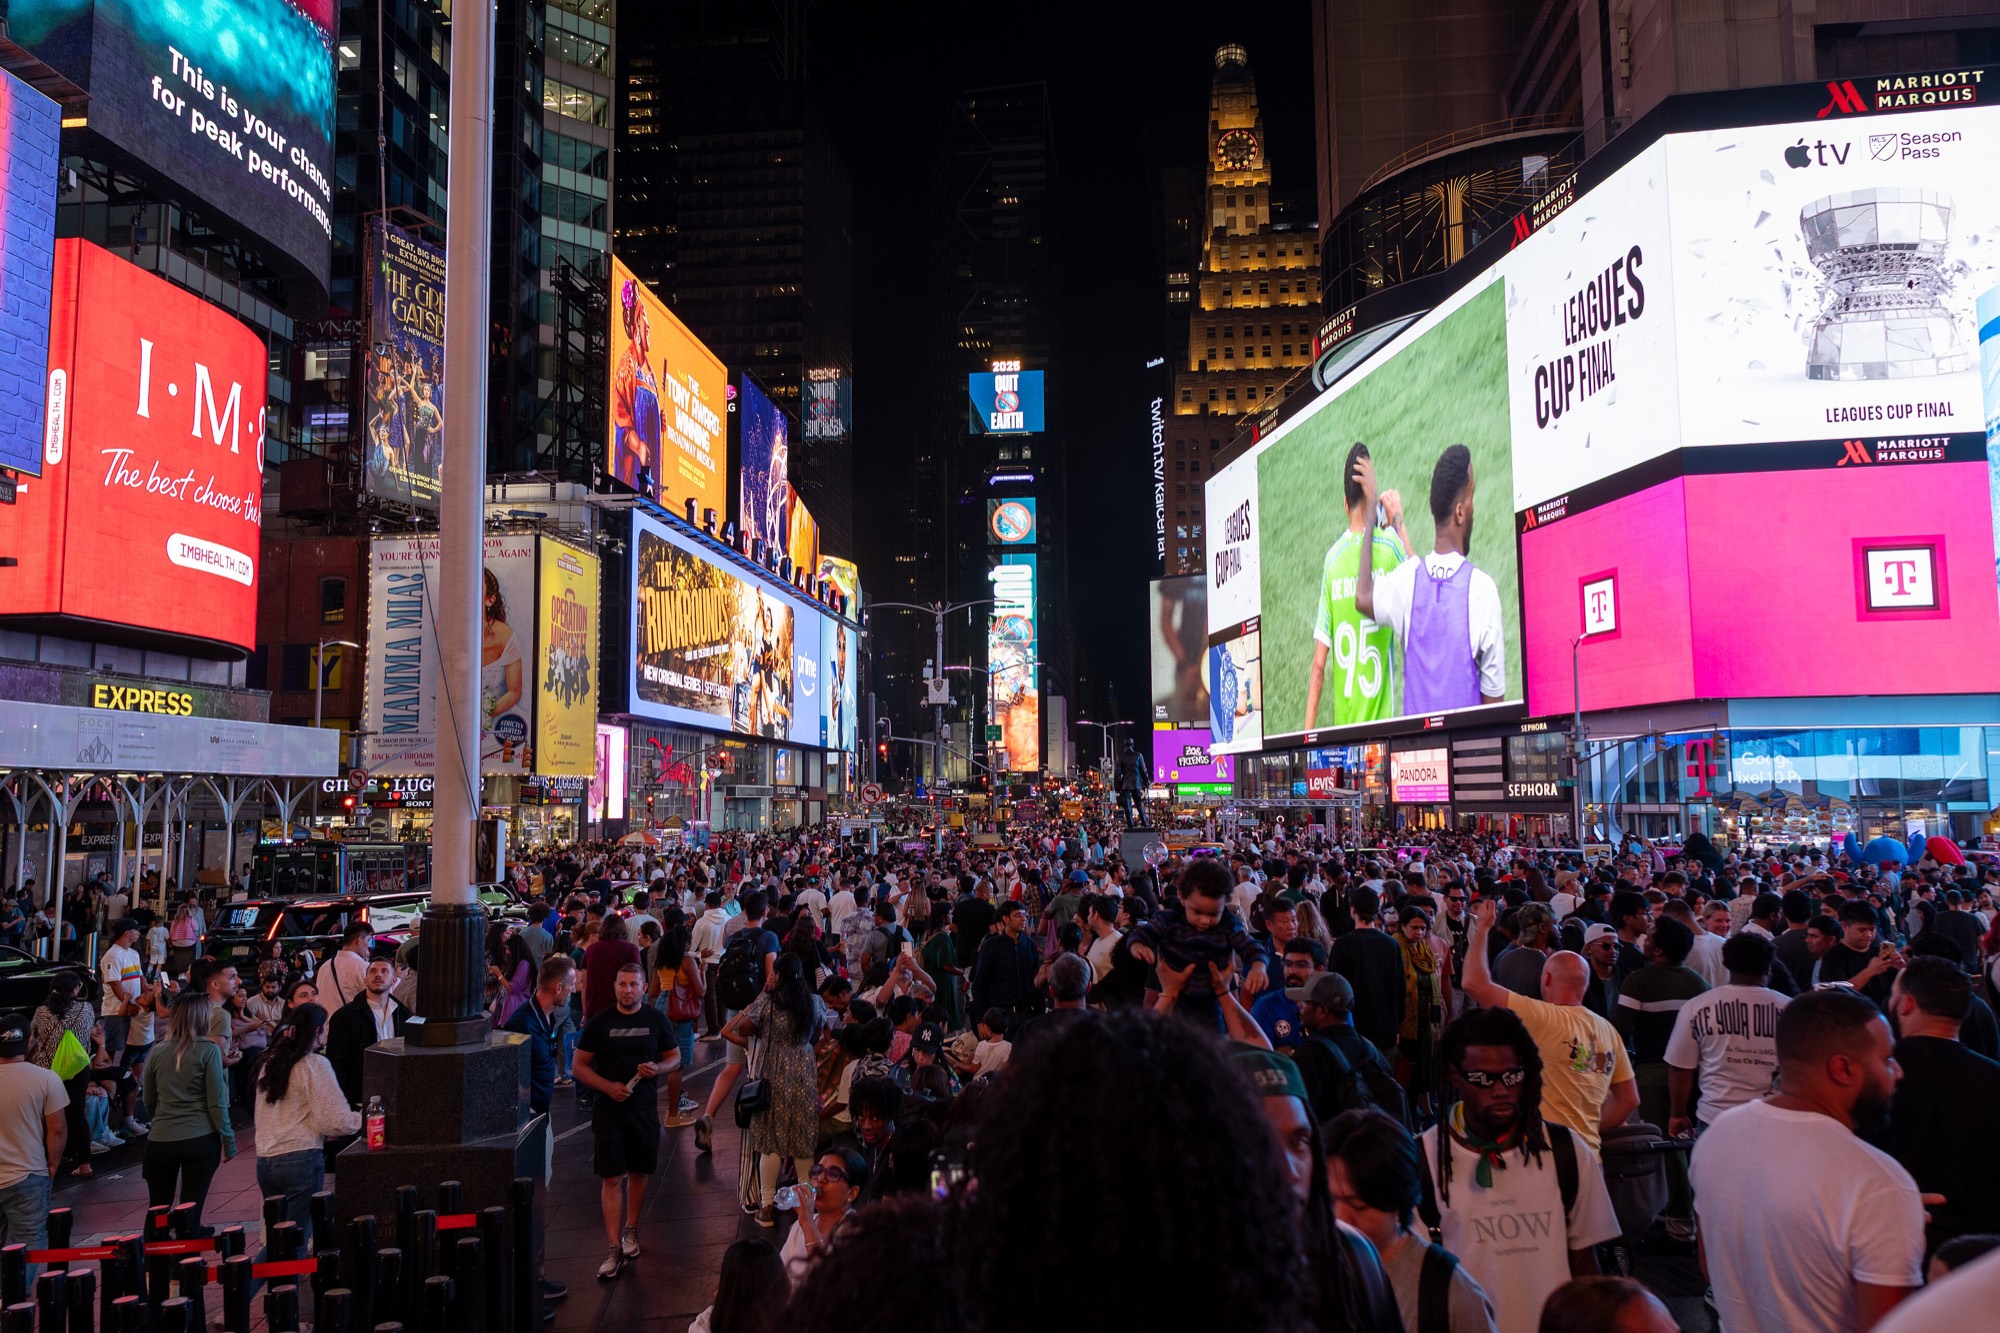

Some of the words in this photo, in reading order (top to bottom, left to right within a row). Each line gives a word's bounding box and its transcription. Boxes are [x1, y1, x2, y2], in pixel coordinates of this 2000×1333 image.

[1877, 70, 1984, 92] MARRIOTT
[1878, 88, 1973, 108] MARQUIS
[168, 46, 214, 100] This
[220, 86, 238, 118] is
[244, 108, 286, 153] your
[290, 147, 330, 202] chance
[1900, 130, 1962, 146] Season
[152, 76, 186, 116] for
[191, 108, 244, 160] peak
[248, 149, 332, 240] performanc
[1814, 140, 1851, 166] tv
[1901, 146, 1940, 160] Pass
[1532, 172, 1578, 215] MARRIOTT
[1533, 192, 1574, 230] MARQUIS
[390, 234, 416, 254] GREAT,
[417, 247, 430, 260] BIG
[387, 267, 412, 300] THE
[414, 282, 446, 315] GRE
[1564, 244, 1645, 346] LEAGUES
[408, 326, 422, 338] NEW
[1320, 306, 1357, 338] MARRIOTT
[1321, 322, 1352, 350] MARQUIS
[666, 373, 690, 412] TONY
[688, 374, 700, 398] THE
[994, 374, 1019, 394] QUIT
[1534, 354, 1574, 430] CUP
[1578, 338, 1616, 402] FINAL
[726, 403, 736, 412] G
[1826, 404, 1882, 423] LEAGUES
[1886, 404, 1914, 420] CUP
[1917, 402, 1954, 420] FINAL
[675, 406, 710, 454] WINNING
[990, 412, 1024, 430] EARTH
[668, 425, 696, 458] BROADWAY
[696, 444, 716, 474] MUSICAL
[1876, 438, 1951, 450] MARRIOTT
[1877, 448, 1943, 460] MARQUIS
[101, 448, 142, 487] The
[146, 460, 194, 500] best
[194, 475, 242, 514] choose
[244, 492, 257, 524] the
[1538, 496, 1569, 514] MARRIOTT
[1538, 508, 1566, 524] MARQUIS
[1224, 498, 1250, 546] LEAGUES
[380, 551, 412, 561] YOU'RE
[408, 541, 427, 550] YOU
[498, 549, 532, 558] AGAIN!
[656, 562, 674, 588] THE
[1215, 549, 1229, 590] CUP
[1230, 546, 1242, 579] FINAL
[386, 572, 424, 630] MIA!
[1332, 578, 1343, 600] DE
[1344, 576, 1357, 599] RO
[552, 595, 588, 632] OPERATION
[646, 586, 730, 655] RUNAROUNDS
[798, 652, 816, 679] prime
[1334, 619, 1382, 698] 95
[312, 656, 342, 688] Y
[382, 635, 422, 735] MAMMA
[644, 664, 658, 680] NEW
[658, 668, 684, 686] ORIGINAL
[684, 674, 702, 690] SERIES
[94, 684, 193, 716] EXPRESS
[80, 718, 112, 728] ROCK
[500, 720, 524, 729] STRICTLY
[1521, 722, 1548, 732] SEPHORA
[1178, 756, 1210, 766] FRIENDS
[554, 777, 584, 789] LUGGAGE
[1400, 768, 1437, 782] PANDORA
[1508, 783, 1558, 797] SEPHORA
[1715, 998, 1749, 1040] YOUR
[1470, 1211, 1552, 1243] NOW
